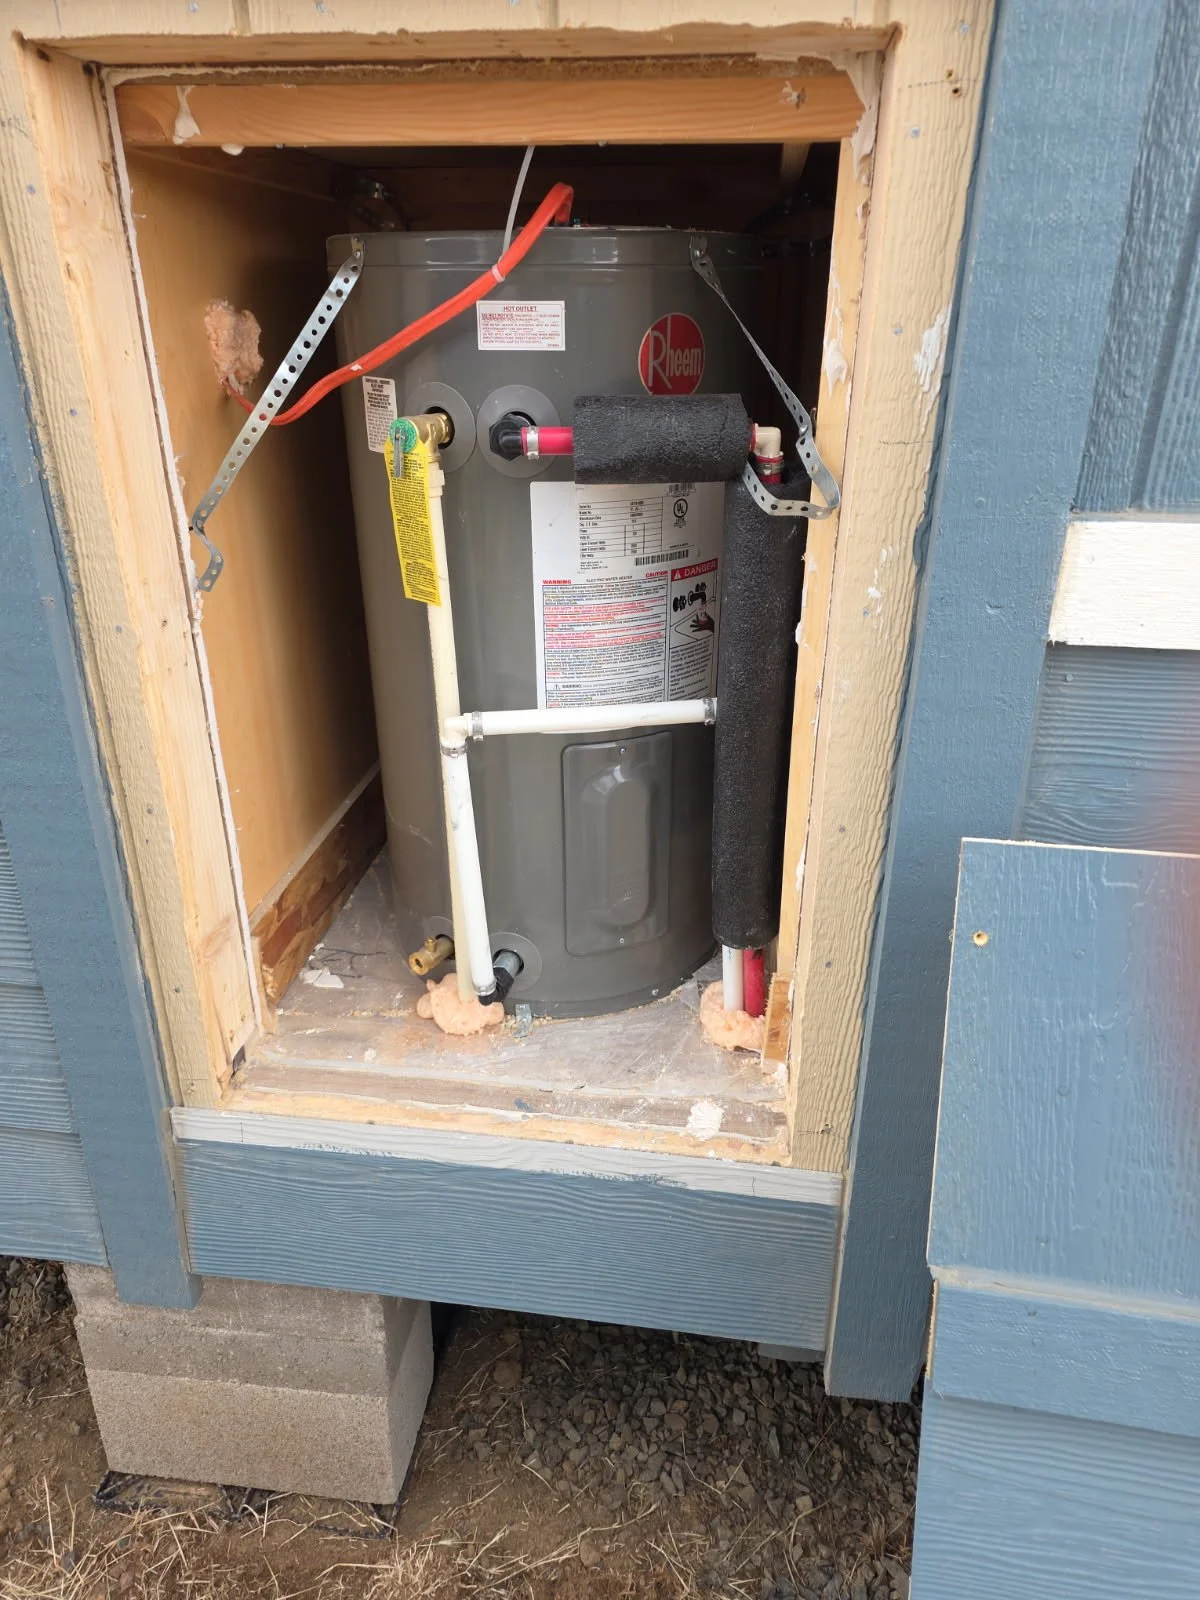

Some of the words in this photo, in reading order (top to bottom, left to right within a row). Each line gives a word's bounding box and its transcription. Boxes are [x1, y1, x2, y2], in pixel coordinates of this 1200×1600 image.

[504, 305, 515, 313] HOT
[515, 305, 537, 313] OUTLET
[648, 316, 702, 390] Rheem
[645, 570, 668, 578] CAUTION
[684, 560, 716, 577] DANGER
